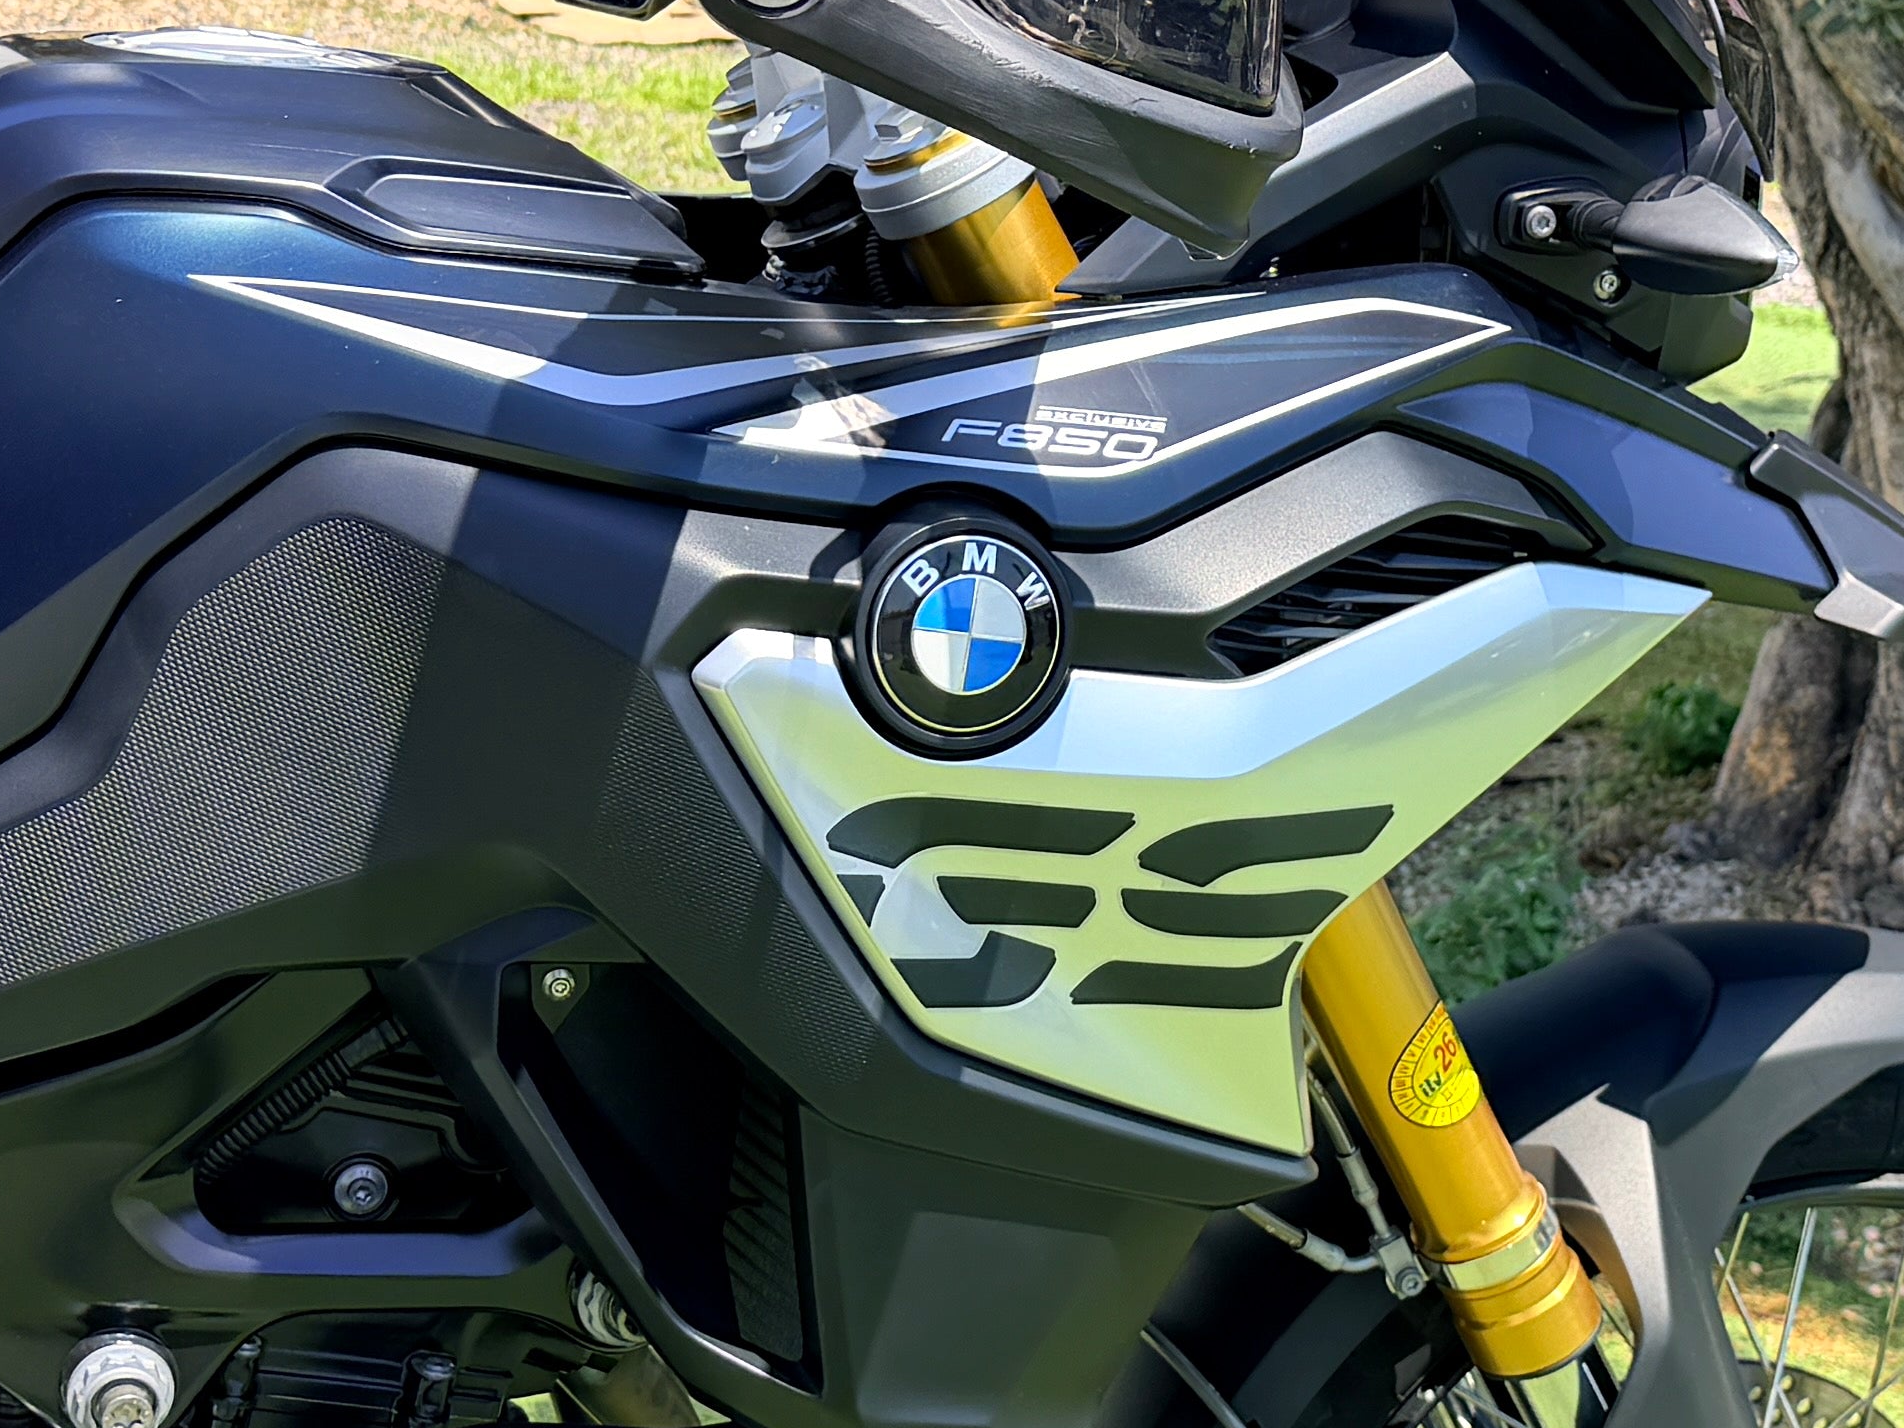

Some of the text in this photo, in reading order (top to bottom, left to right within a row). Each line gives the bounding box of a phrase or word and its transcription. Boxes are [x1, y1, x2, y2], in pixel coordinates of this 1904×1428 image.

[941, 417, 1159, 461] F850
[902, 541, 1051, 611] BMW
[1433, 1030, 1457, 1073] 26
